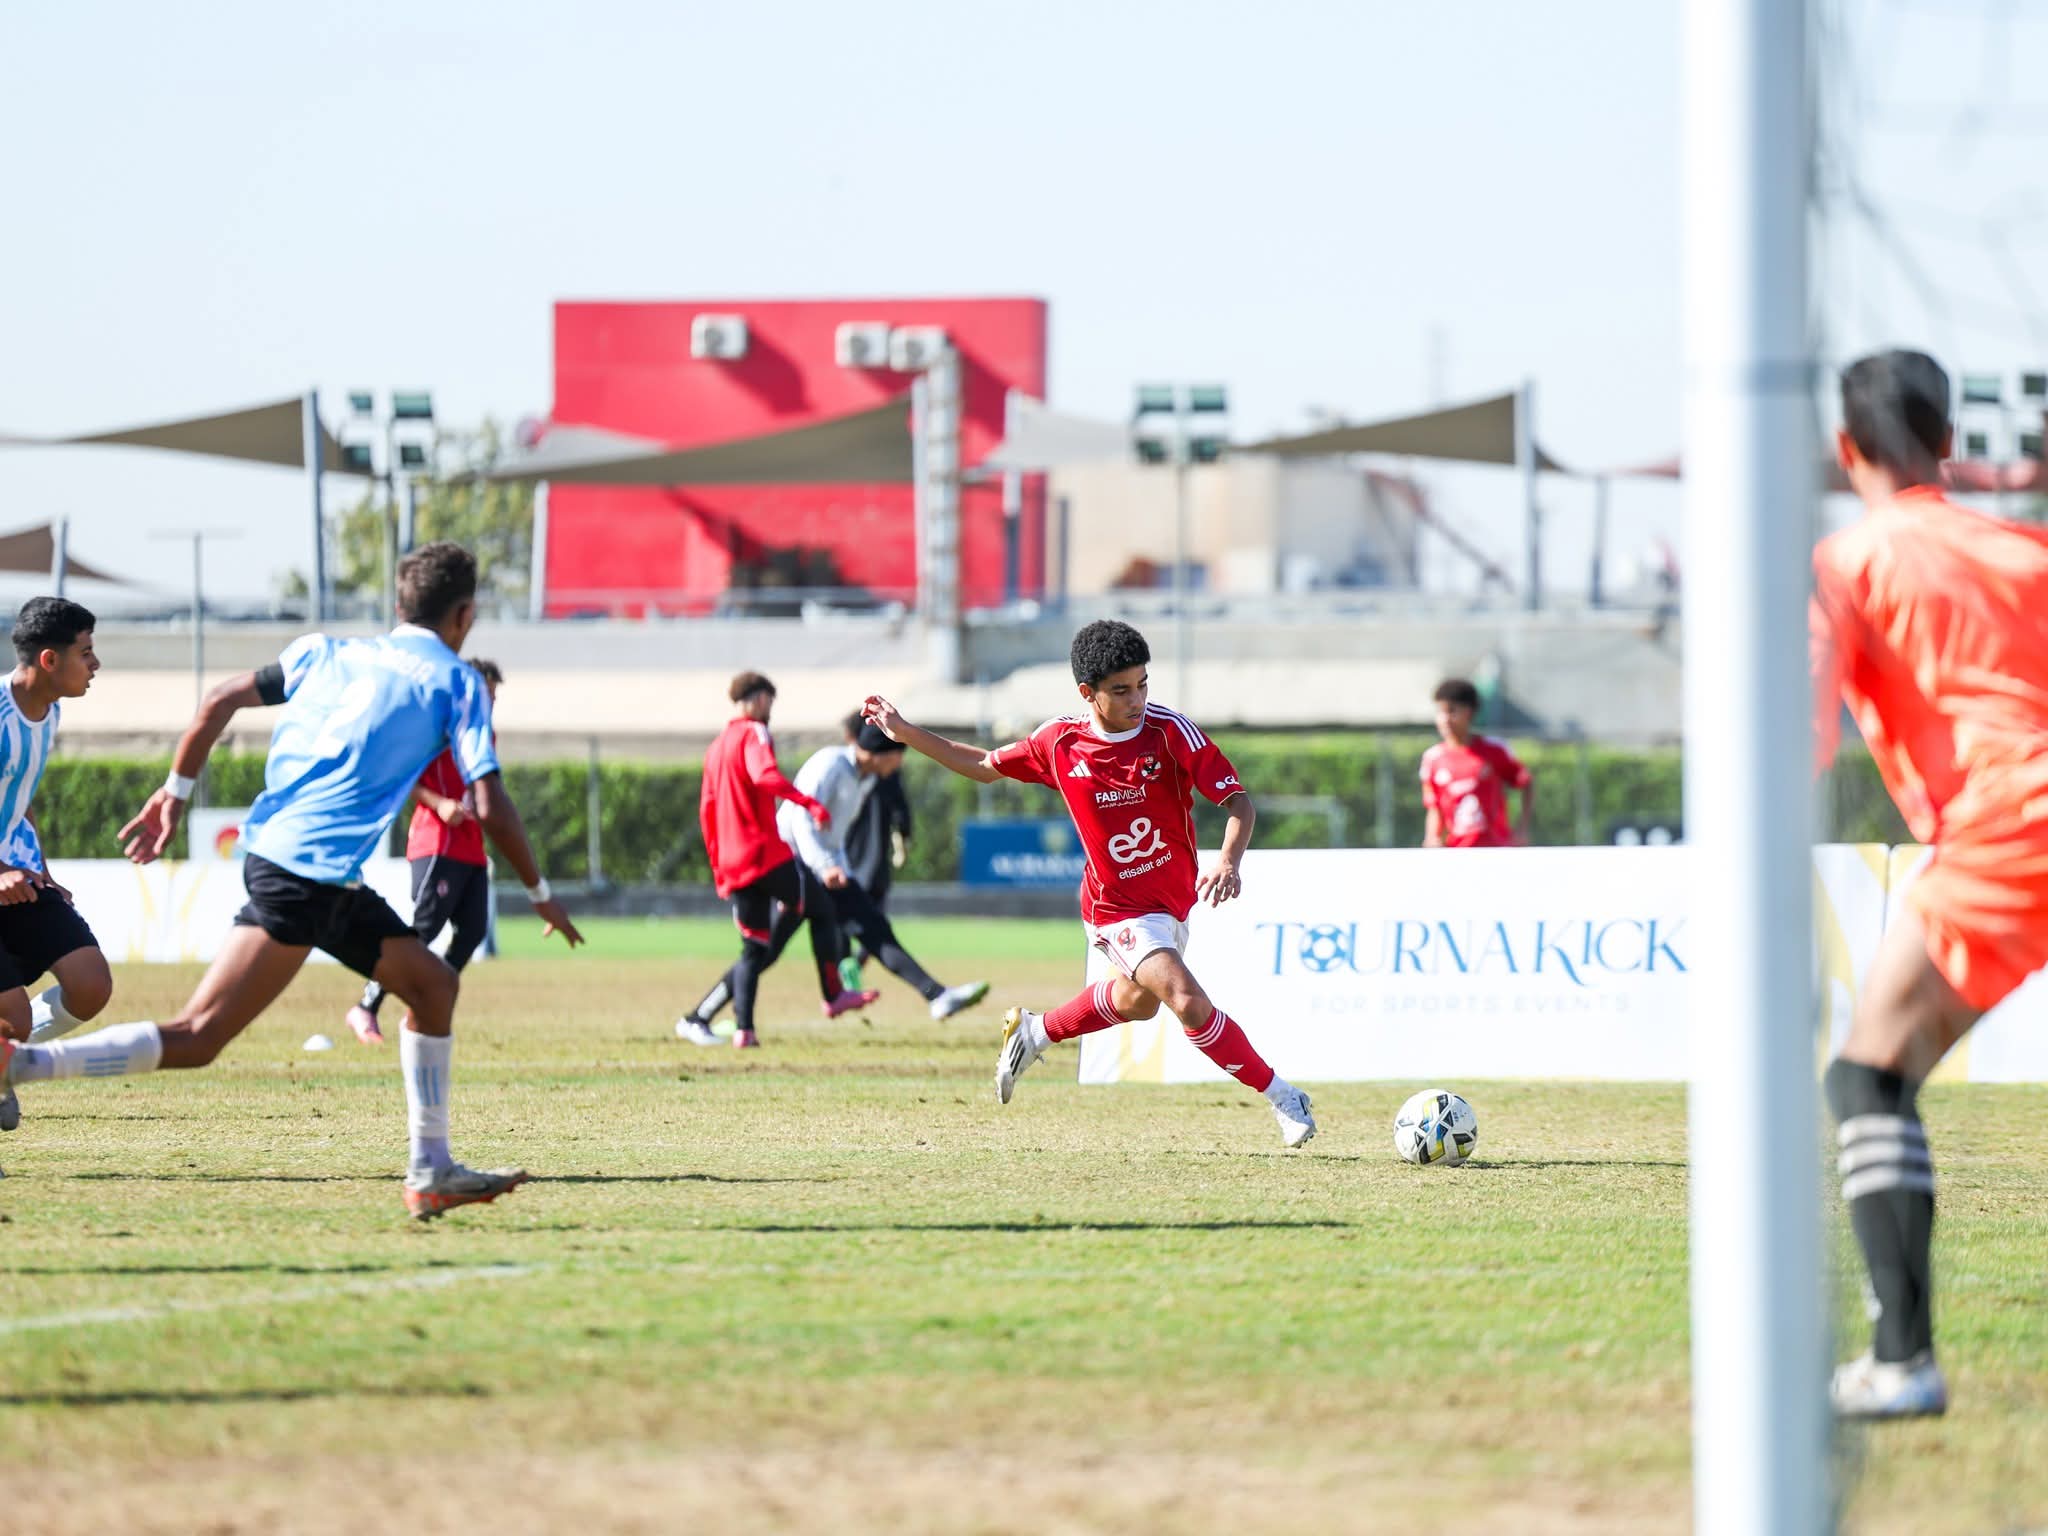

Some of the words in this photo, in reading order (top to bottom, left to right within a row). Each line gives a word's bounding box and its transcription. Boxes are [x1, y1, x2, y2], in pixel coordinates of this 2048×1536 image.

[1095, 787, 1144, 804] FABMISR
[1108, 817, 1168, 864] e&
[1118, 862, 1155, 880] etisalat
[1155, 851, 1172, 868] and
[1310, 992, 1367, 1014] FOR
[1381, 992, 1501, 1014] SPORTS
[1514, 992, 1631, 1014] EVENTS
